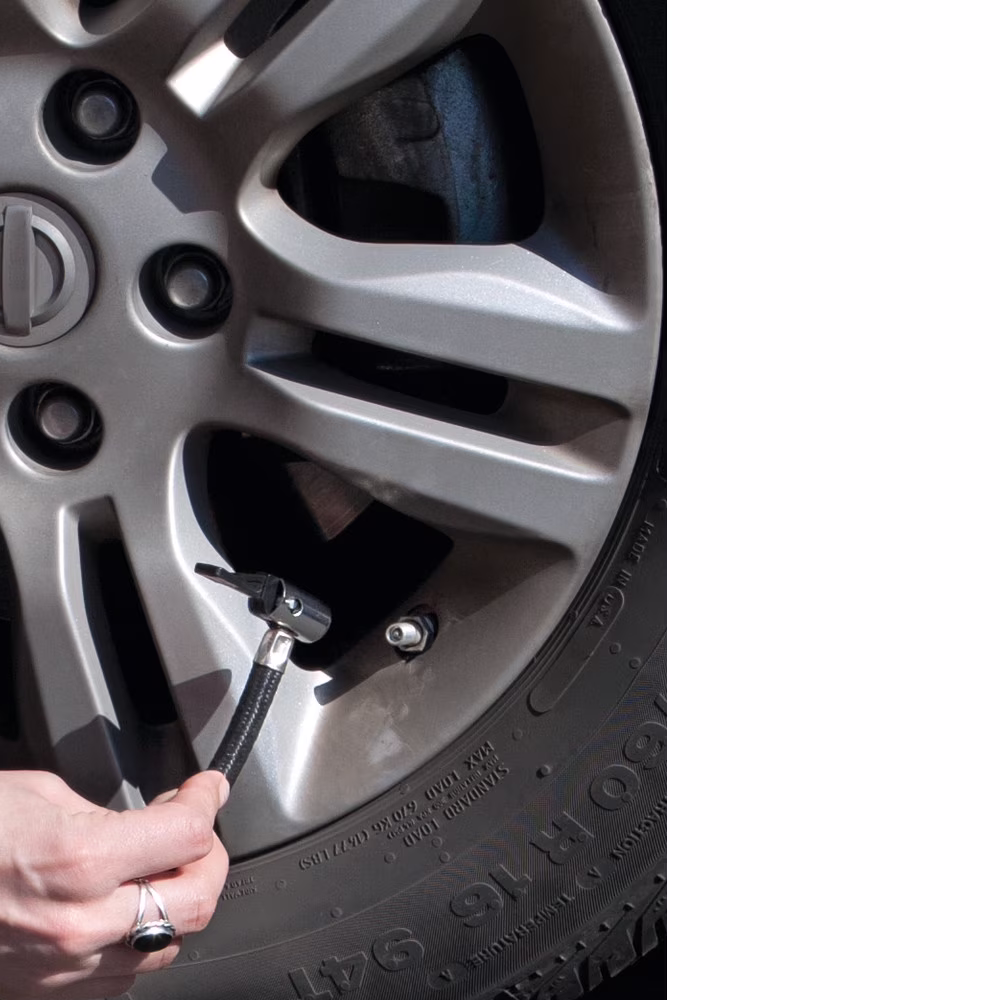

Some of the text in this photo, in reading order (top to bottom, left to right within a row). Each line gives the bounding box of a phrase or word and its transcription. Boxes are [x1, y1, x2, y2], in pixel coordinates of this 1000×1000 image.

[629, 519, 655, 563] MADE
[463, 739, 496, 772] MAX
[424, 768, 461, 803] LOAD
[443, 761, 510, 822] STANDARD
[402, 811, 441, 849] LOAD
[611, 796, 667, 863] RACTION
